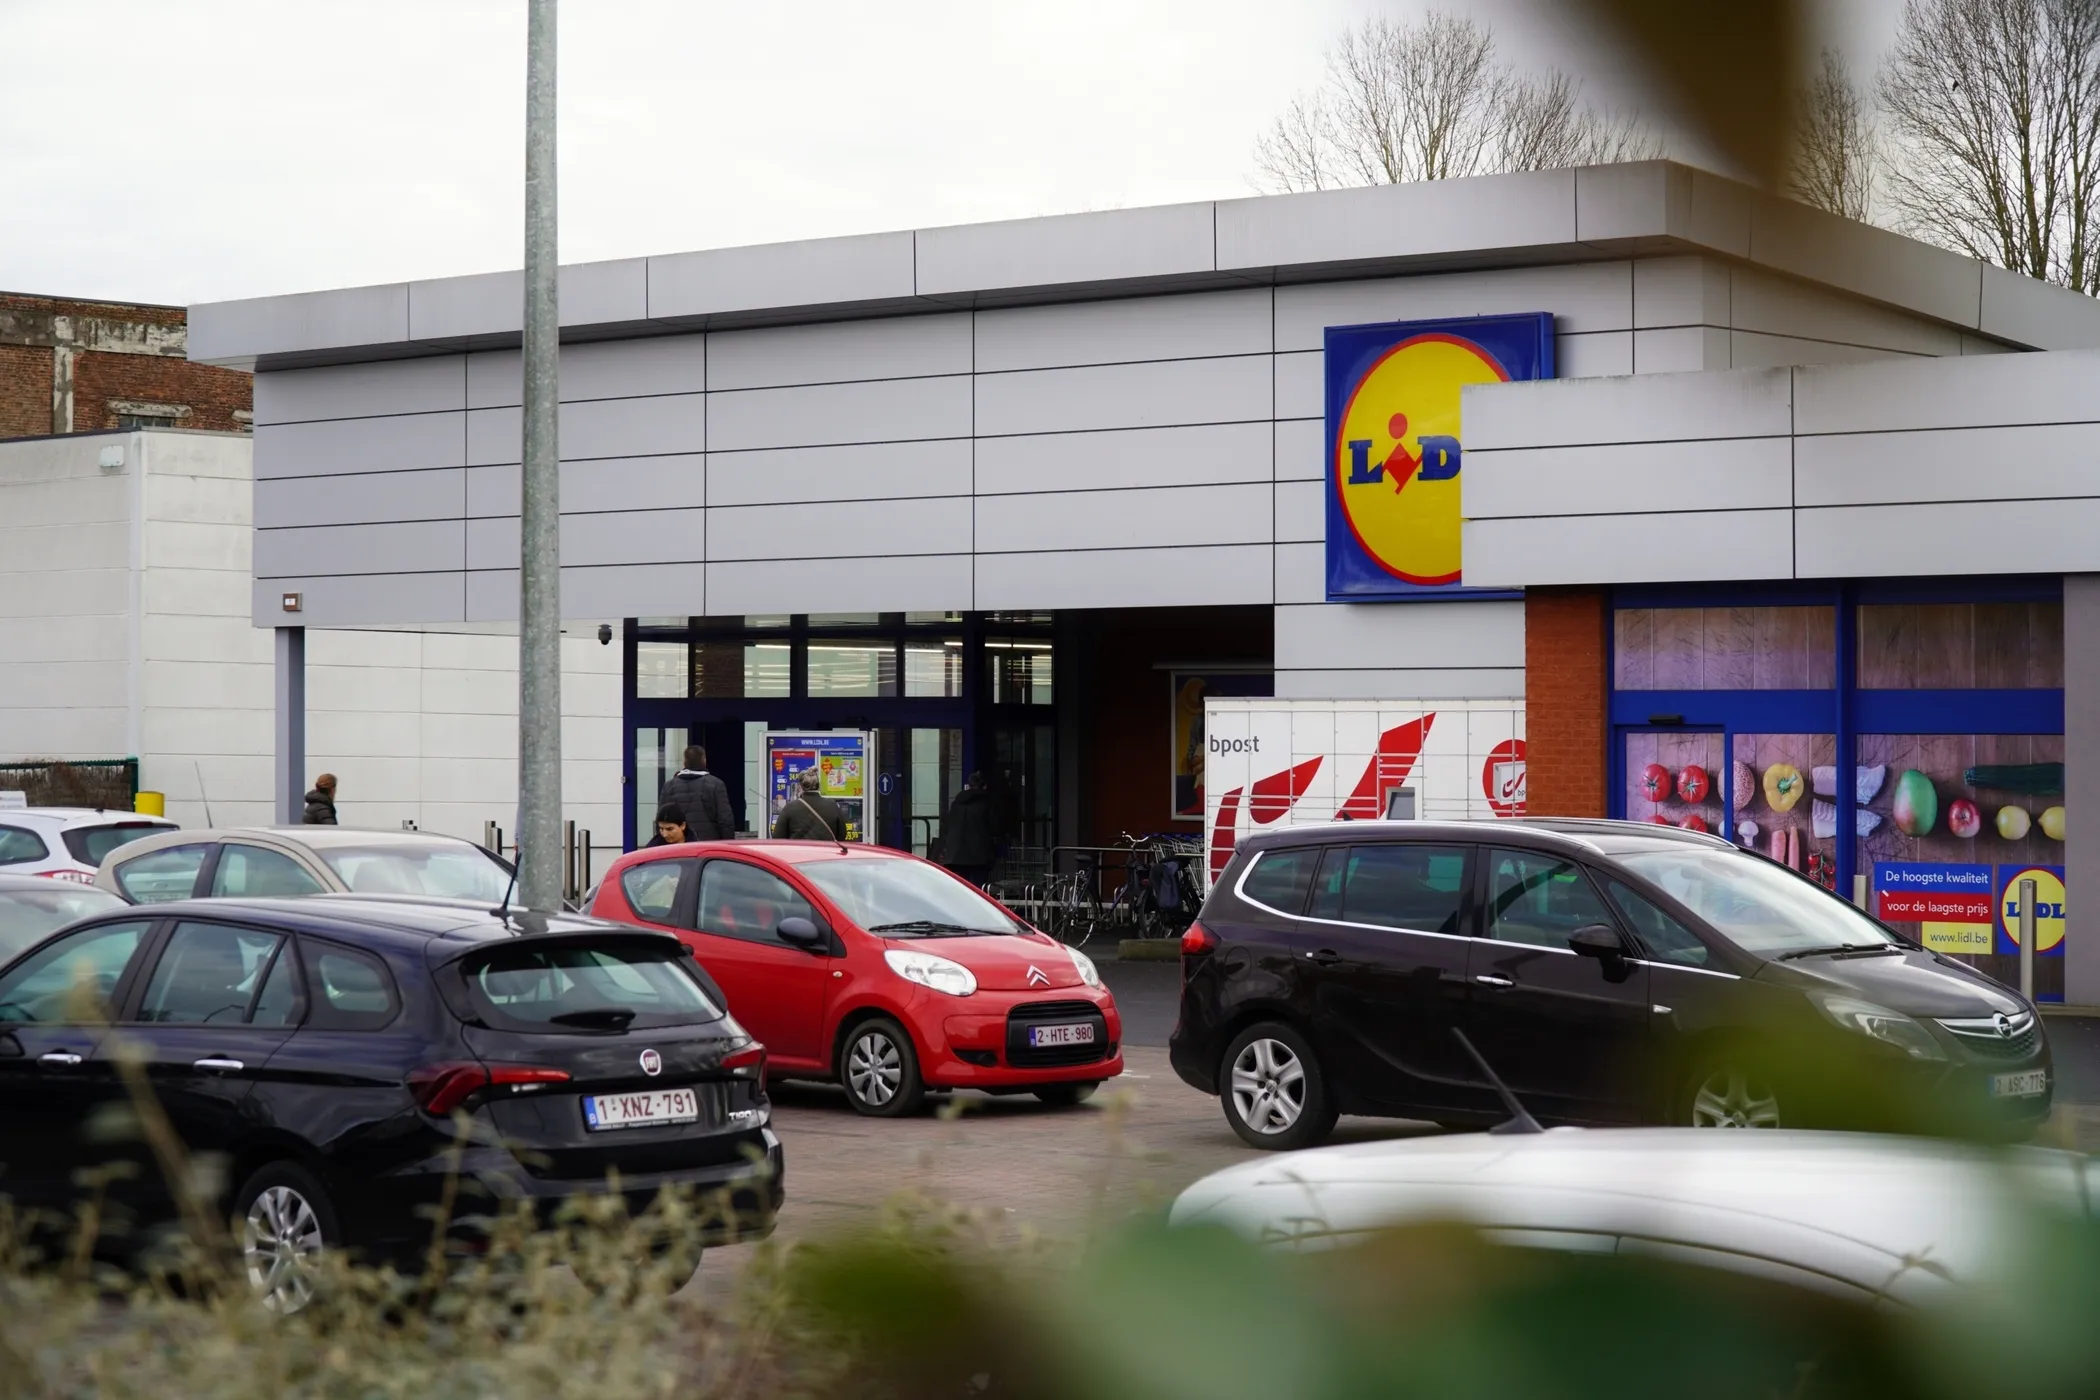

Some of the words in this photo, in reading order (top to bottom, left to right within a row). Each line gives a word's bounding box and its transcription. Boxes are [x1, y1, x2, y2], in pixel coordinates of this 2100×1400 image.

[1348, 412, 1461, 495] LID
[1210, 734, 1259, 757] bpost
[1885, 870, 1900, 882] De
[1902, 870, 1943, 885] hoogste
[1946, 871, 1989, 884] kwaliteit
[1887, 903, 1910, 912] voor
[1912, 901, 1926, 912] de
[1928, 901, 1964, 916] laagste
[1967, 903, 1989, 917] prijs
[2006, 901, 2065, 918] LDL
[1930, 931, 1988, 944] www.lidl.be
